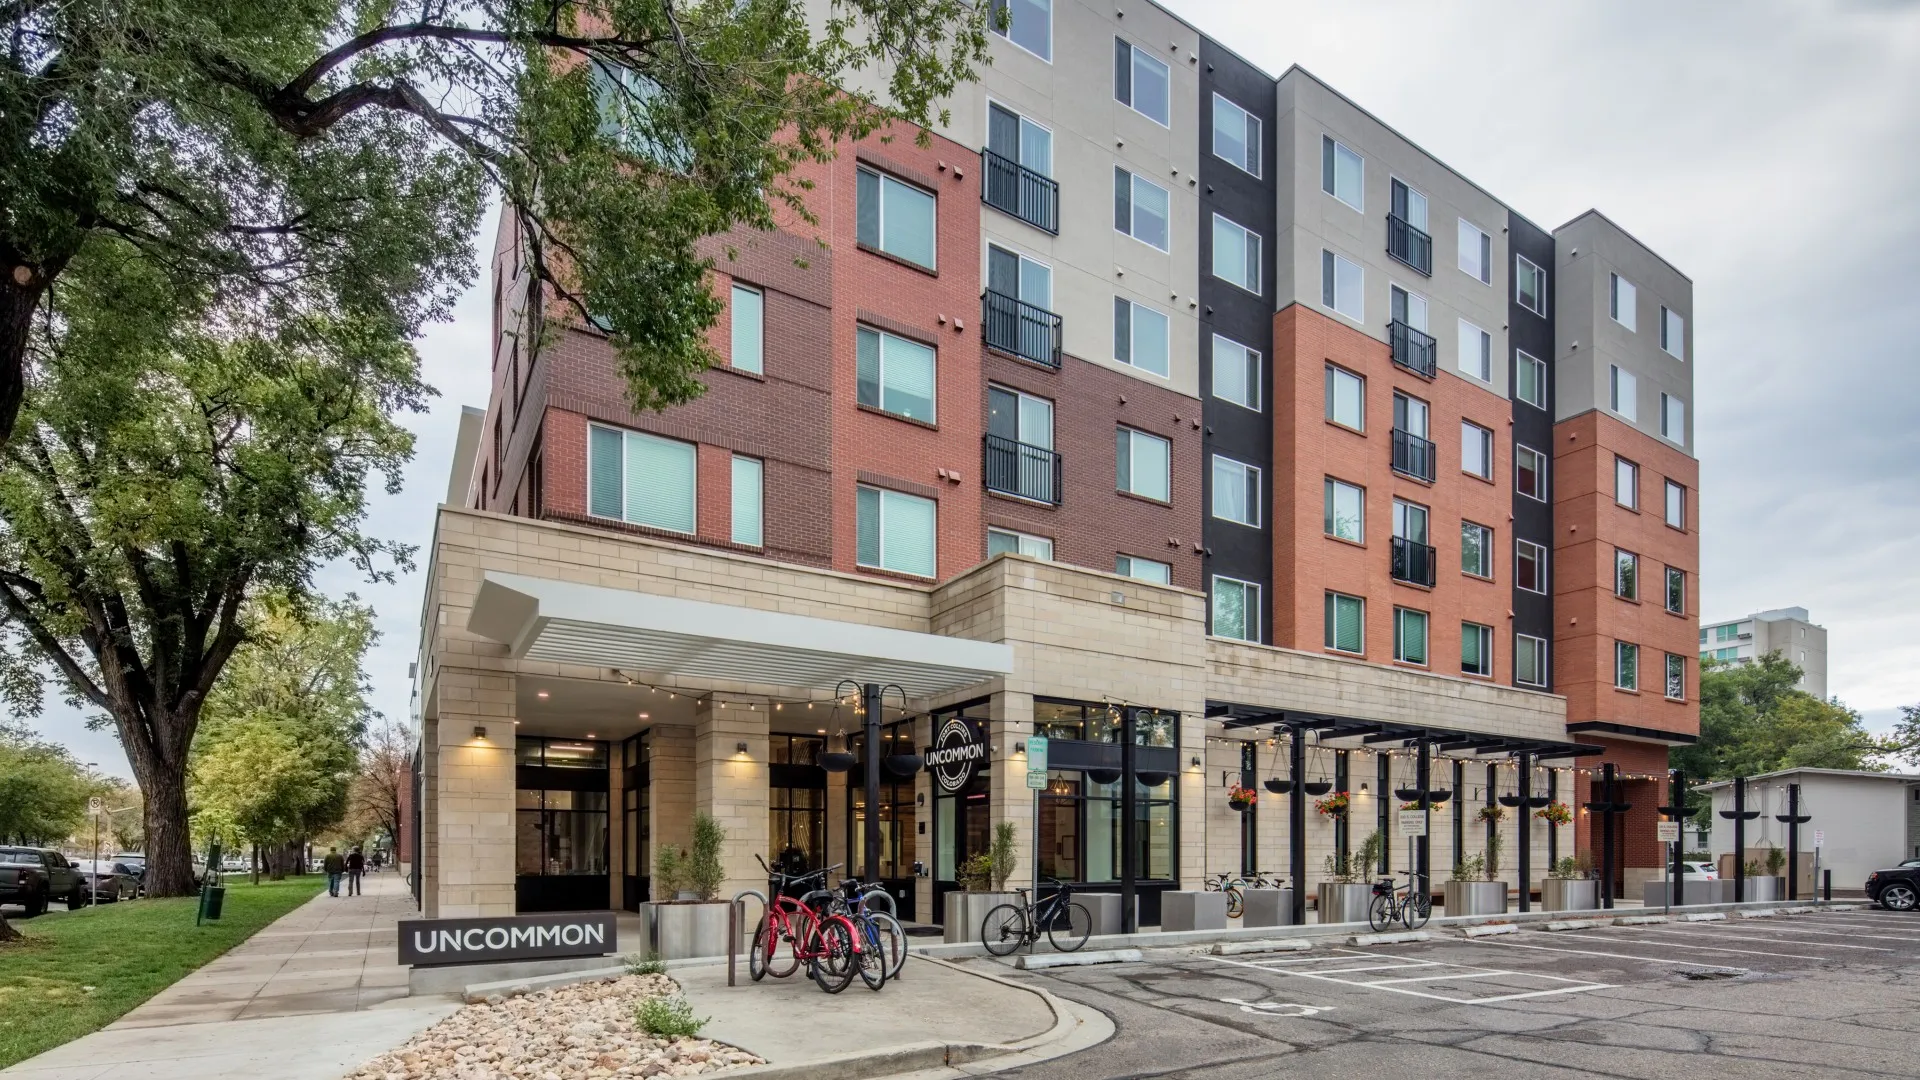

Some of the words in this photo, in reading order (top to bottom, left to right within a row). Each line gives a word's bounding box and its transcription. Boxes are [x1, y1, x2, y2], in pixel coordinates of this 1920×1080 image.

[940, 726, 950, 742] FORT
[950, 723, 968, 738] COLLINS
[925, 742, 984, 766] UNCOMMON
[941, 772, 966, 787] COLORADO
[414, 923, 604, 954] UNCOMMON
